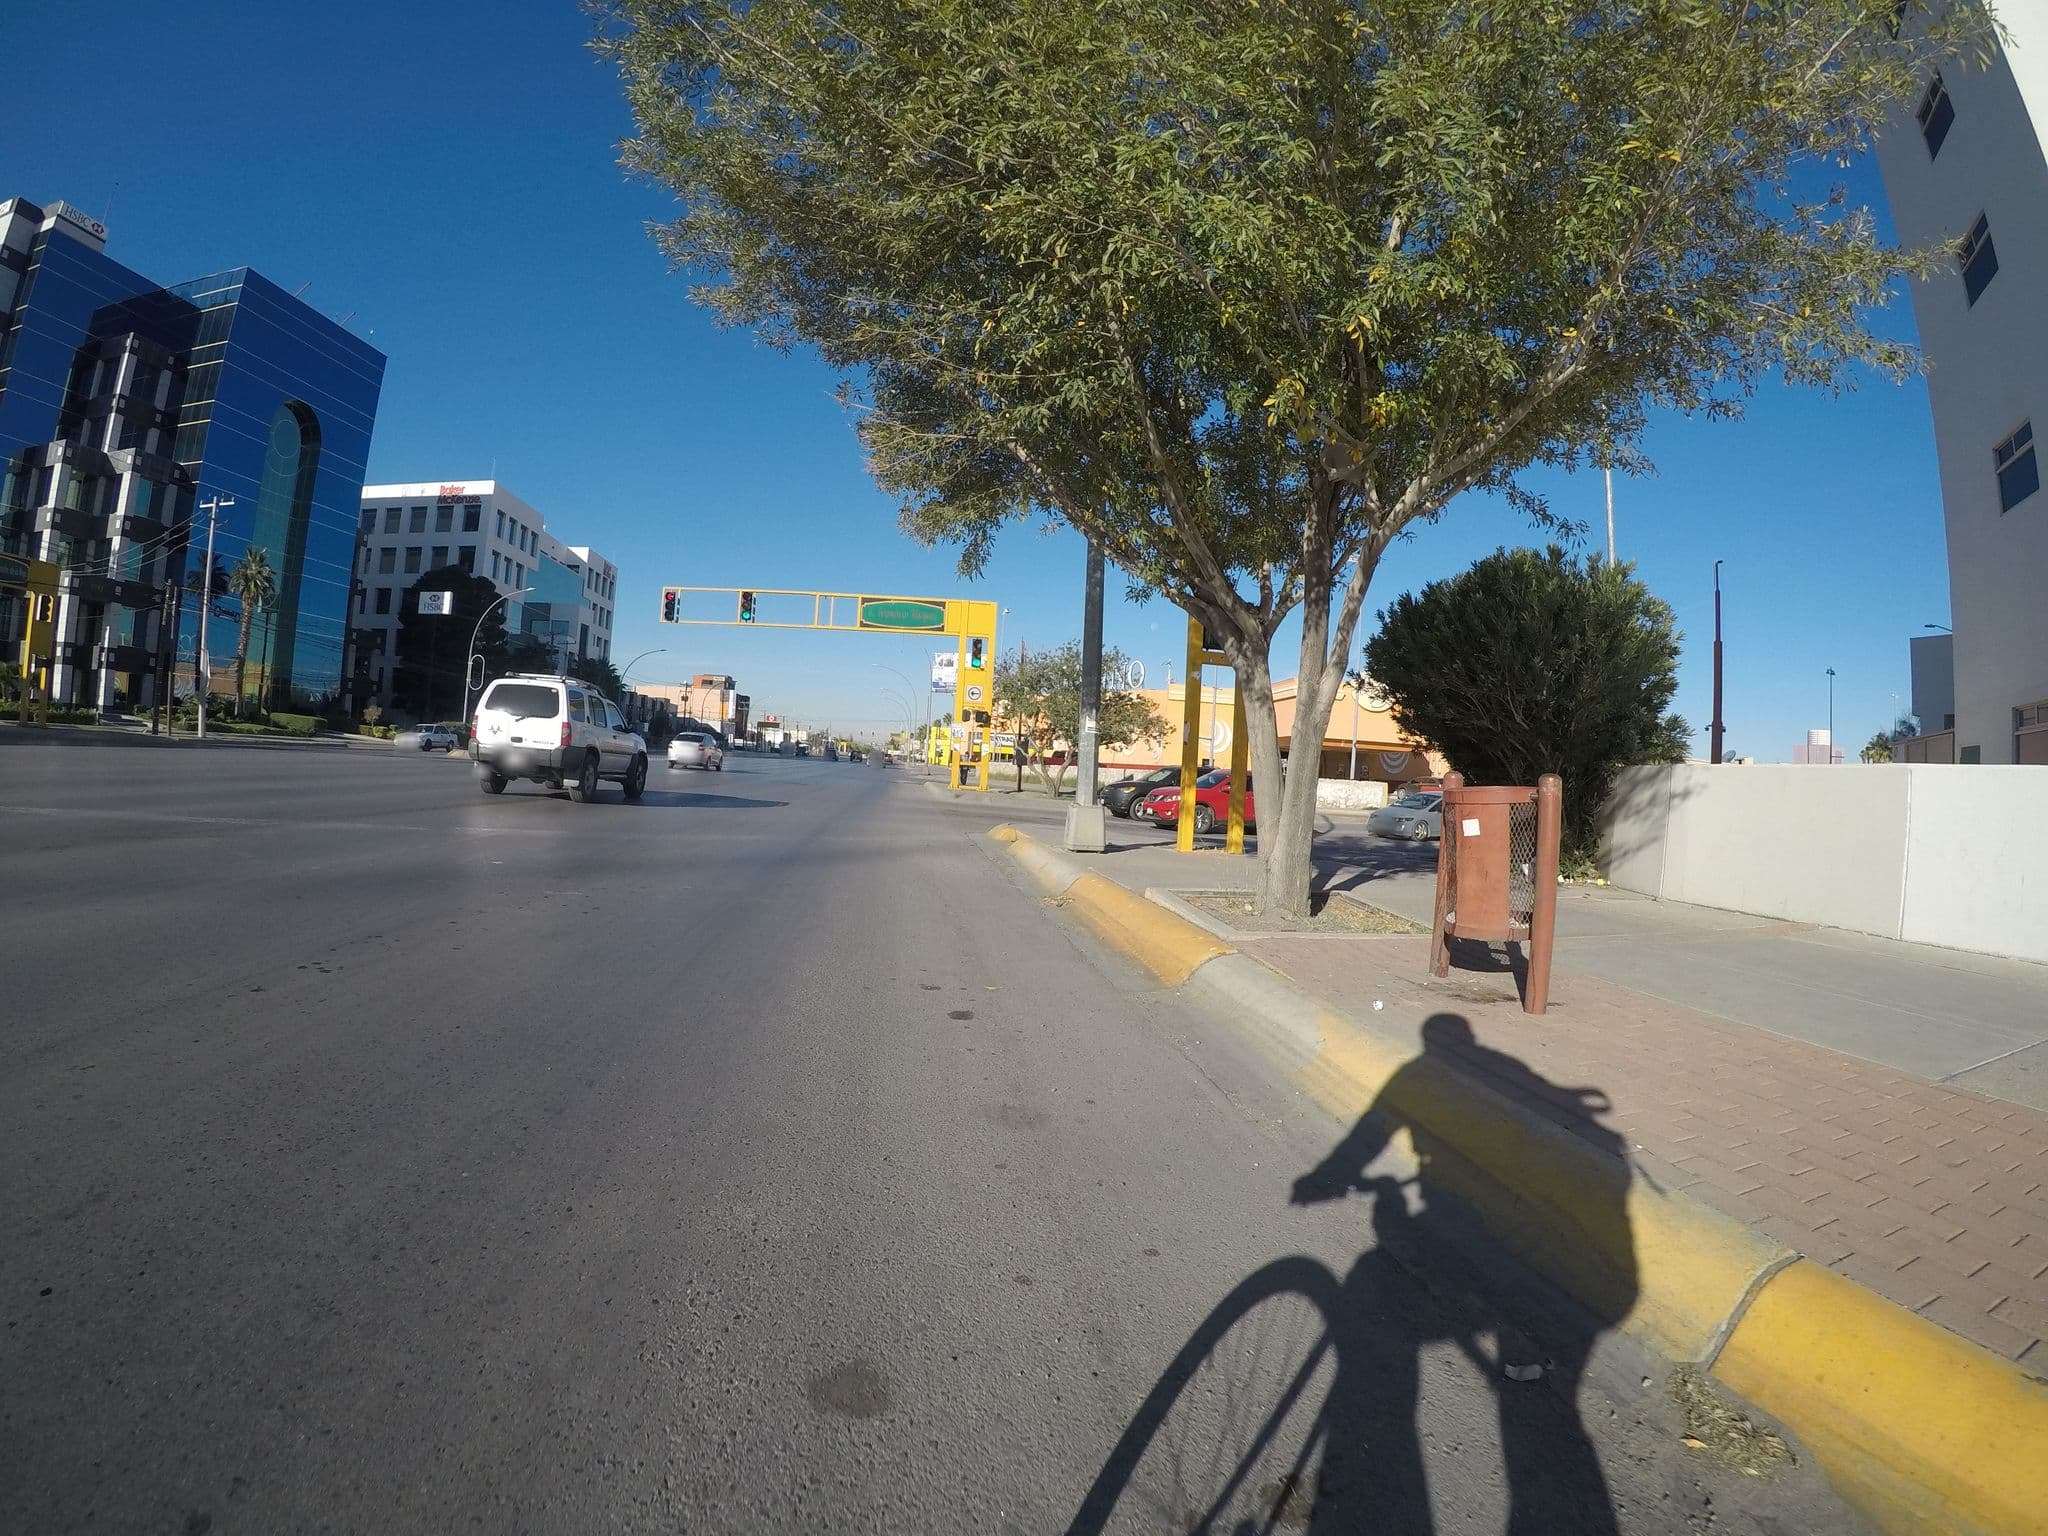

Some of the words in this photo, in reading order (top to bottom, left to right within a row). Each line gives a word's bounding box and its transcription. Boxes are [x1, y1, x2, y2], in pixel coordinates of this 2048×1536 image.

[64, 205, 90, 227] HSBC
[440, 484, 465, 495] Baker
[424, 602, 443, 611] HSBC
